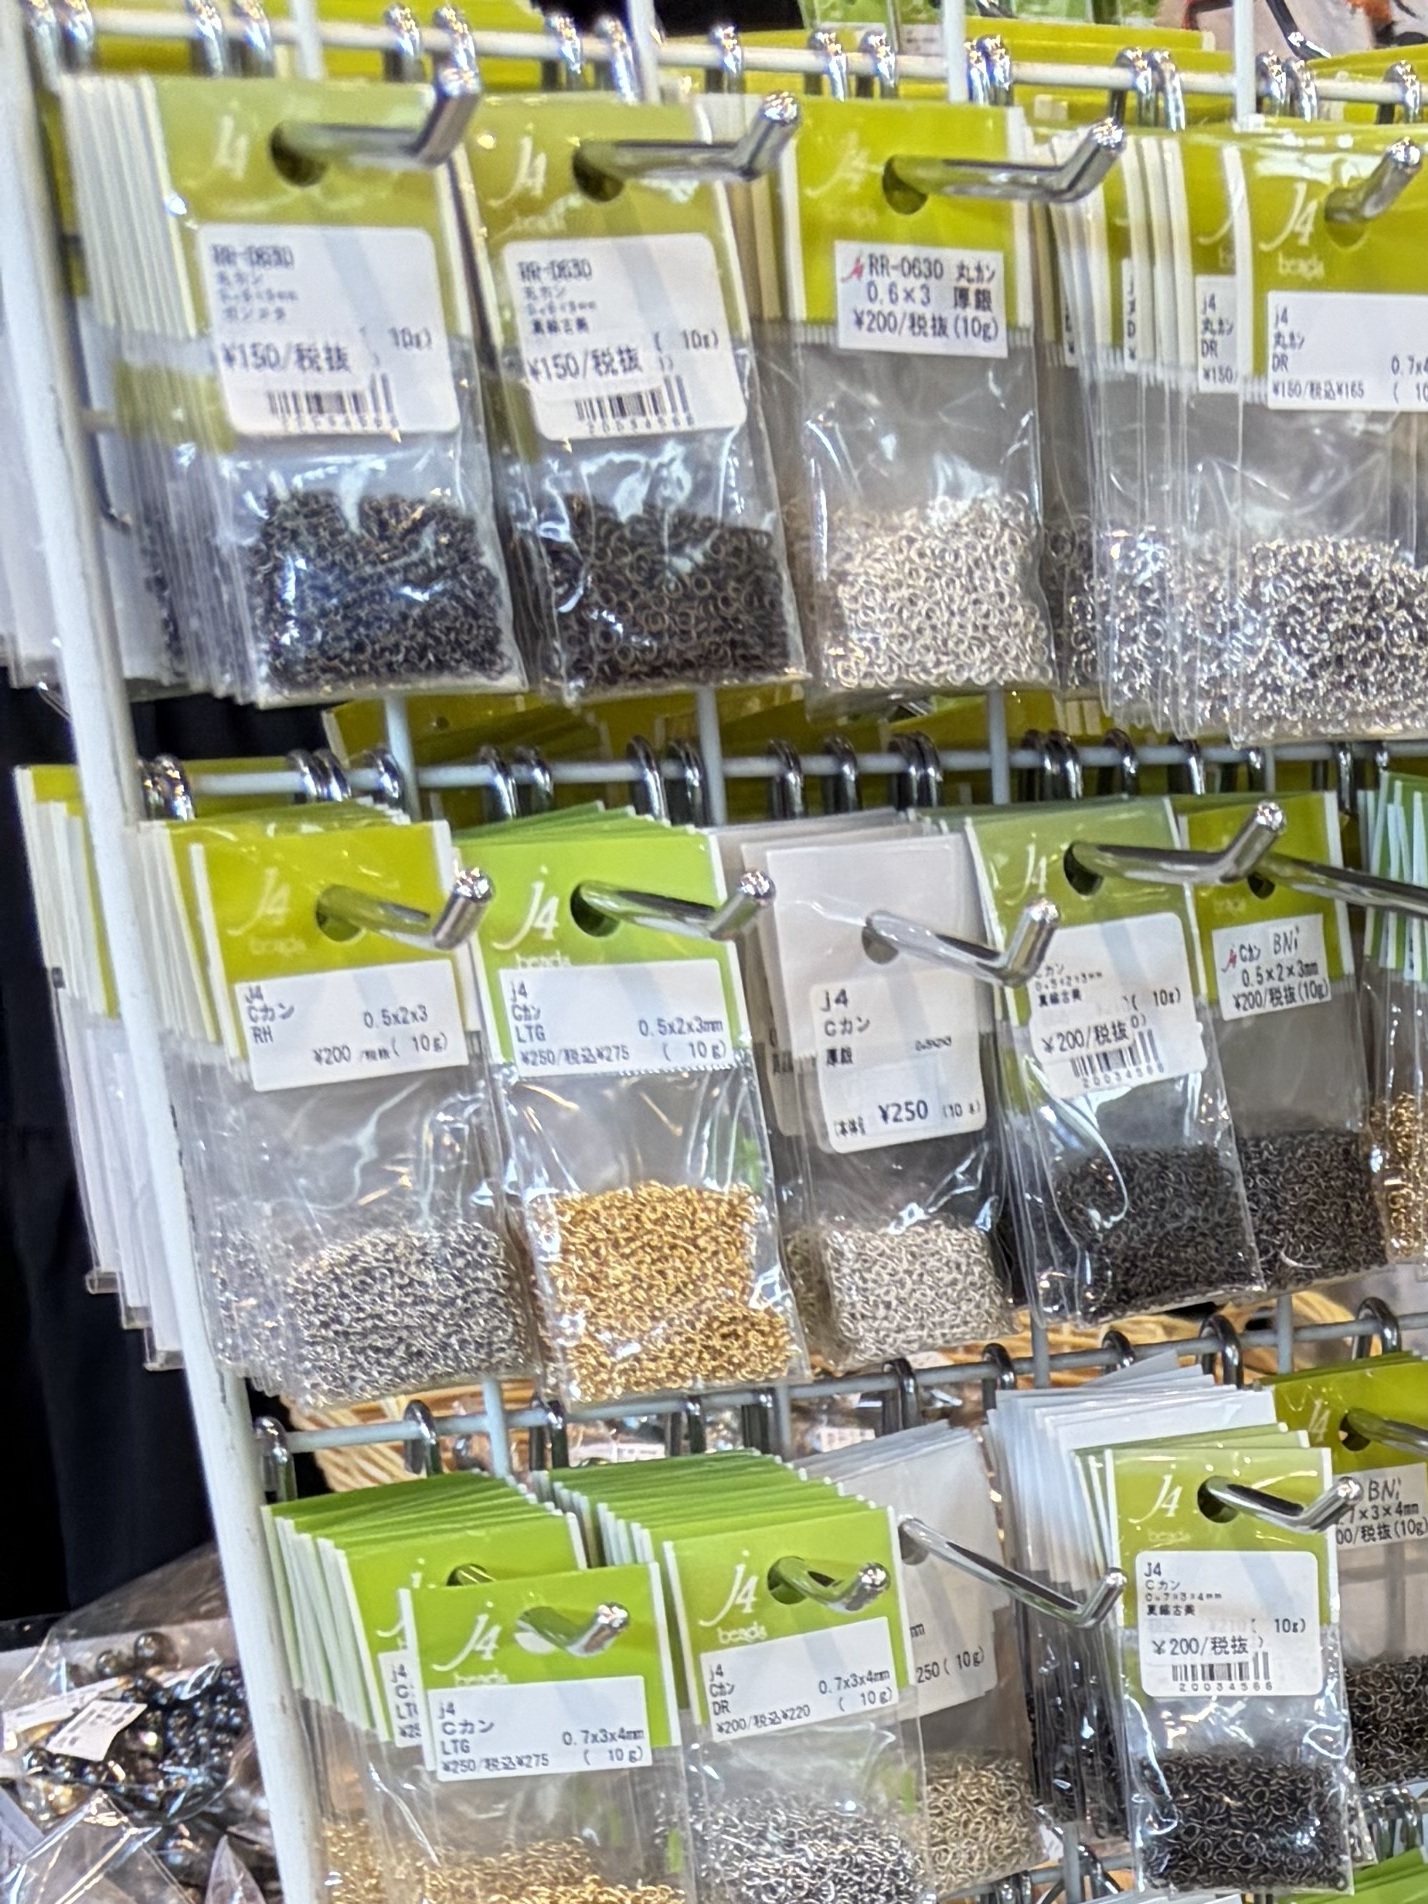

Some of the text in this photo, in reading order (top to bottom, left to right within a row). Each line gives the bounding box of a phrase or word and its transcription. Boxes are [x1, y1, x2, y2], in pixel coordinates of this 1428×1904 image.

[868, 251, 944, 280] RR-0630
[878, 1100, 929, 1124] ¥250
[1152, 1637, 1249, 1657] ¥200/税抜
[442, 1738, 471, 1756] LTG
